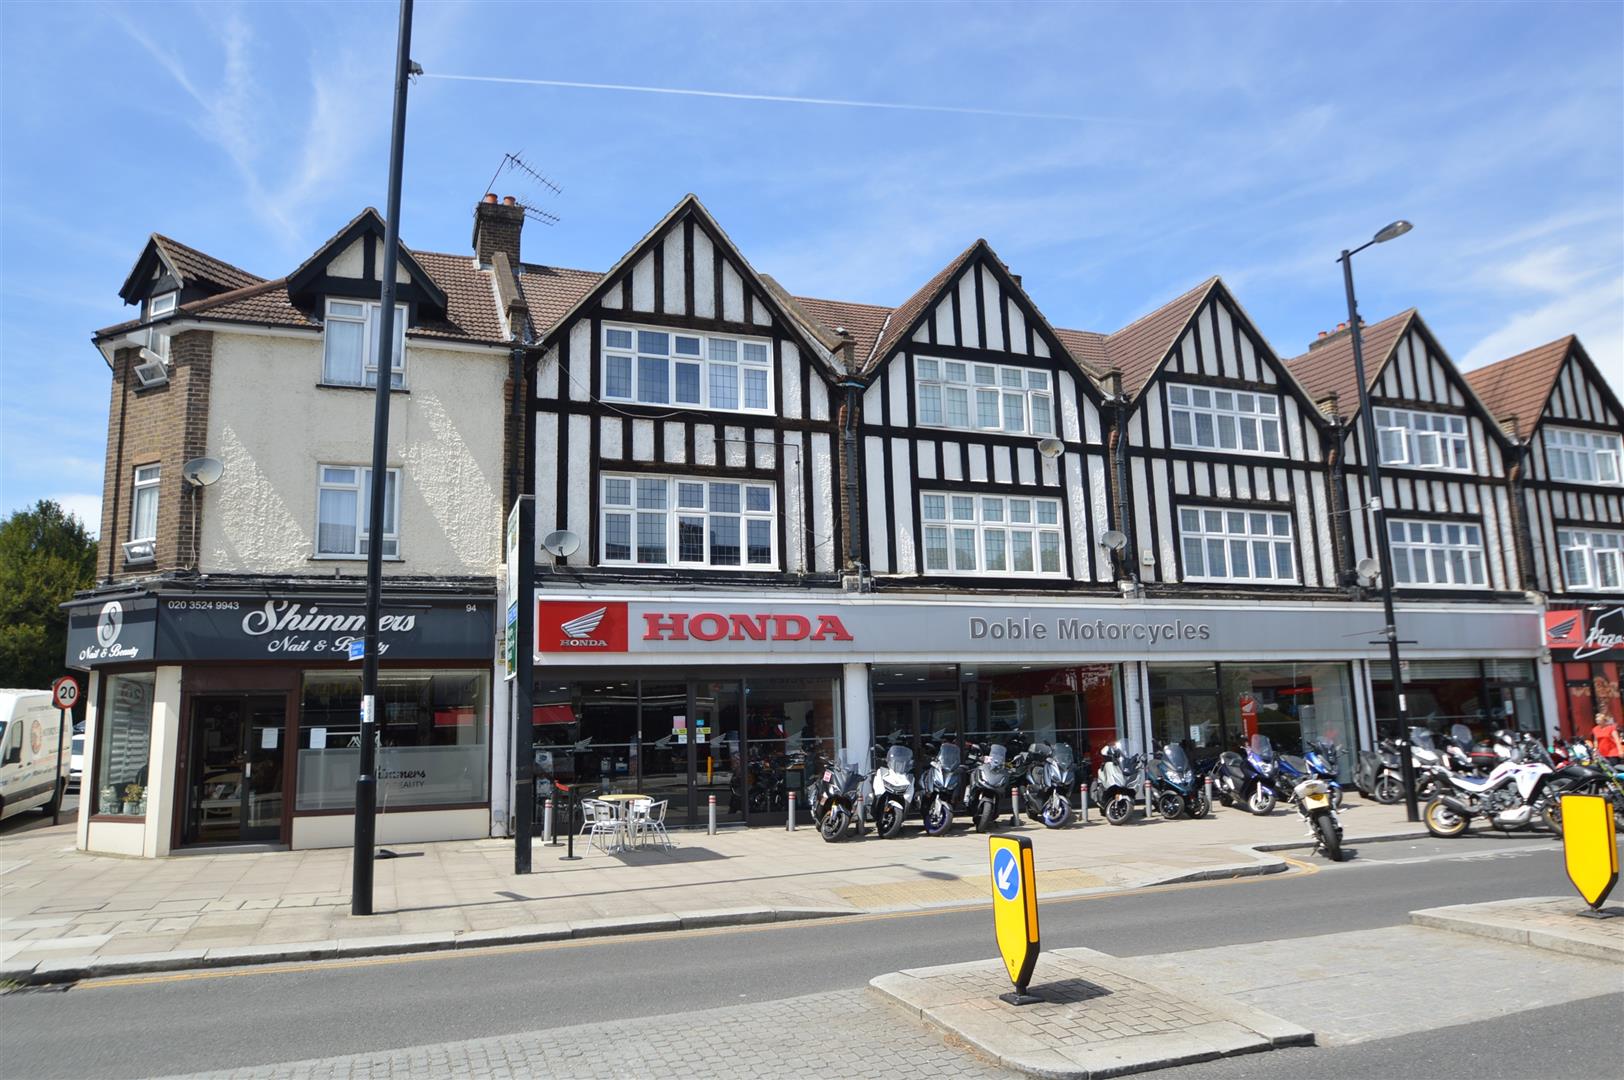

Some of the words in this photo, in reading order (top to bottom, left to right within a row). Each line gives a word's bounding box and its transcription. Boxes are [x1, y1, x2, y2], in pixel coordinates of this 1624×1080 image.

[168, 600, 187, 610] 020
[189, 600, 213, 610] 3524
[215, 601, 240, 611] 9943
[466, 604, 477, 612] 94
[643, 613, 854, 641] HONDA
[969, 617, 1047, 640] Doble
[1057, 617, 1210, 644] Motorcycles
[267, 635, 311, 652] Nail
[313, 640, 327, 652] &
[560, 639, 608, 647] HONDA
[79, 645, 100, 660] Nail
[100, 648, 108, 658] &
[108, 643, 139, 658] Beauty
[60, 686, 76, 699] 20
